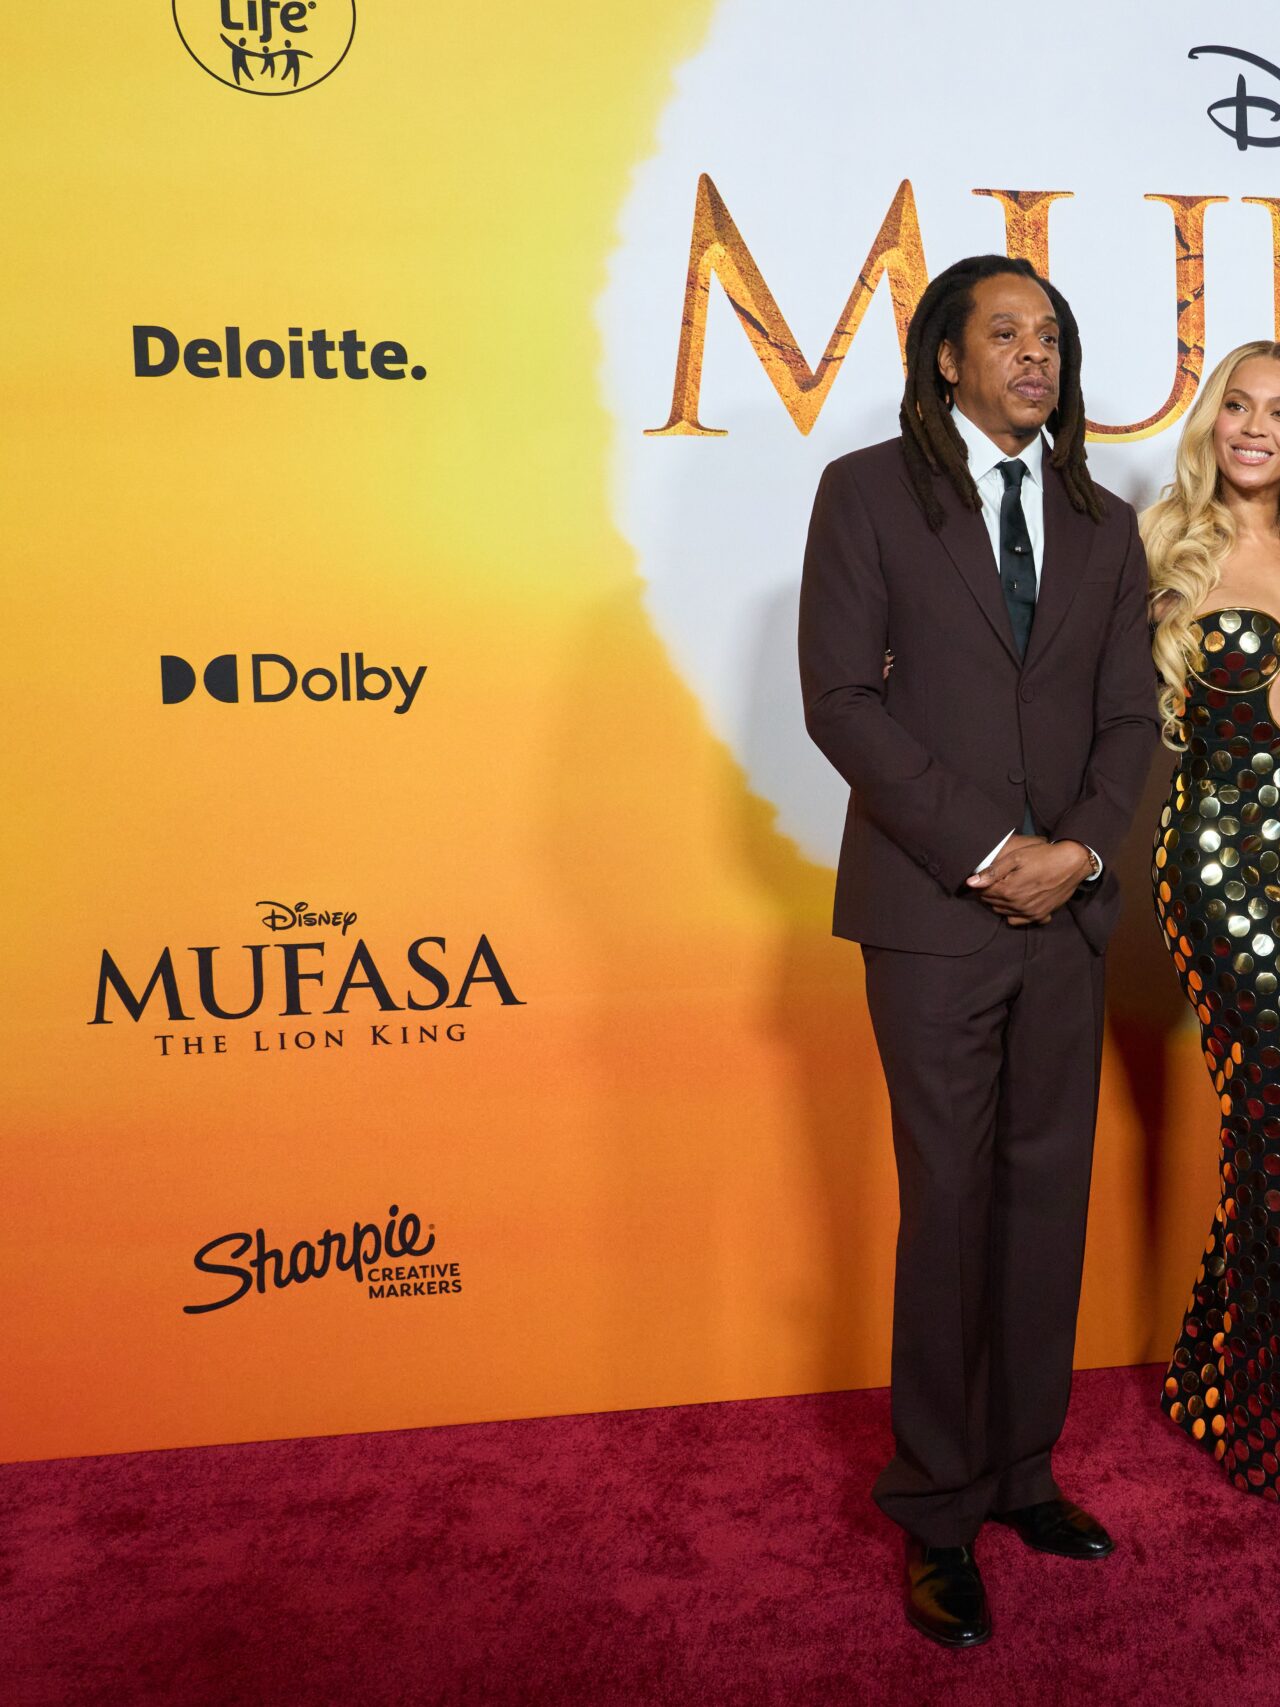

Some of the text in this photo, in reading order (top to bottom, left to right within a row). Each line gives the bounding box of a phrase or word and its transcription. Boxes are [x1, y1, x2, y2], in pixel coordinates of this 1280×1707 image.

[252, 652, 428, 715] Dolby
[87, 933, 527, 1025] MUFASA
[182, 1204, 436, 1315] Sharpie
[367, 1262, 461, 1283] CREATIVE
[368, 1279, 463, 1299] MARKERS
